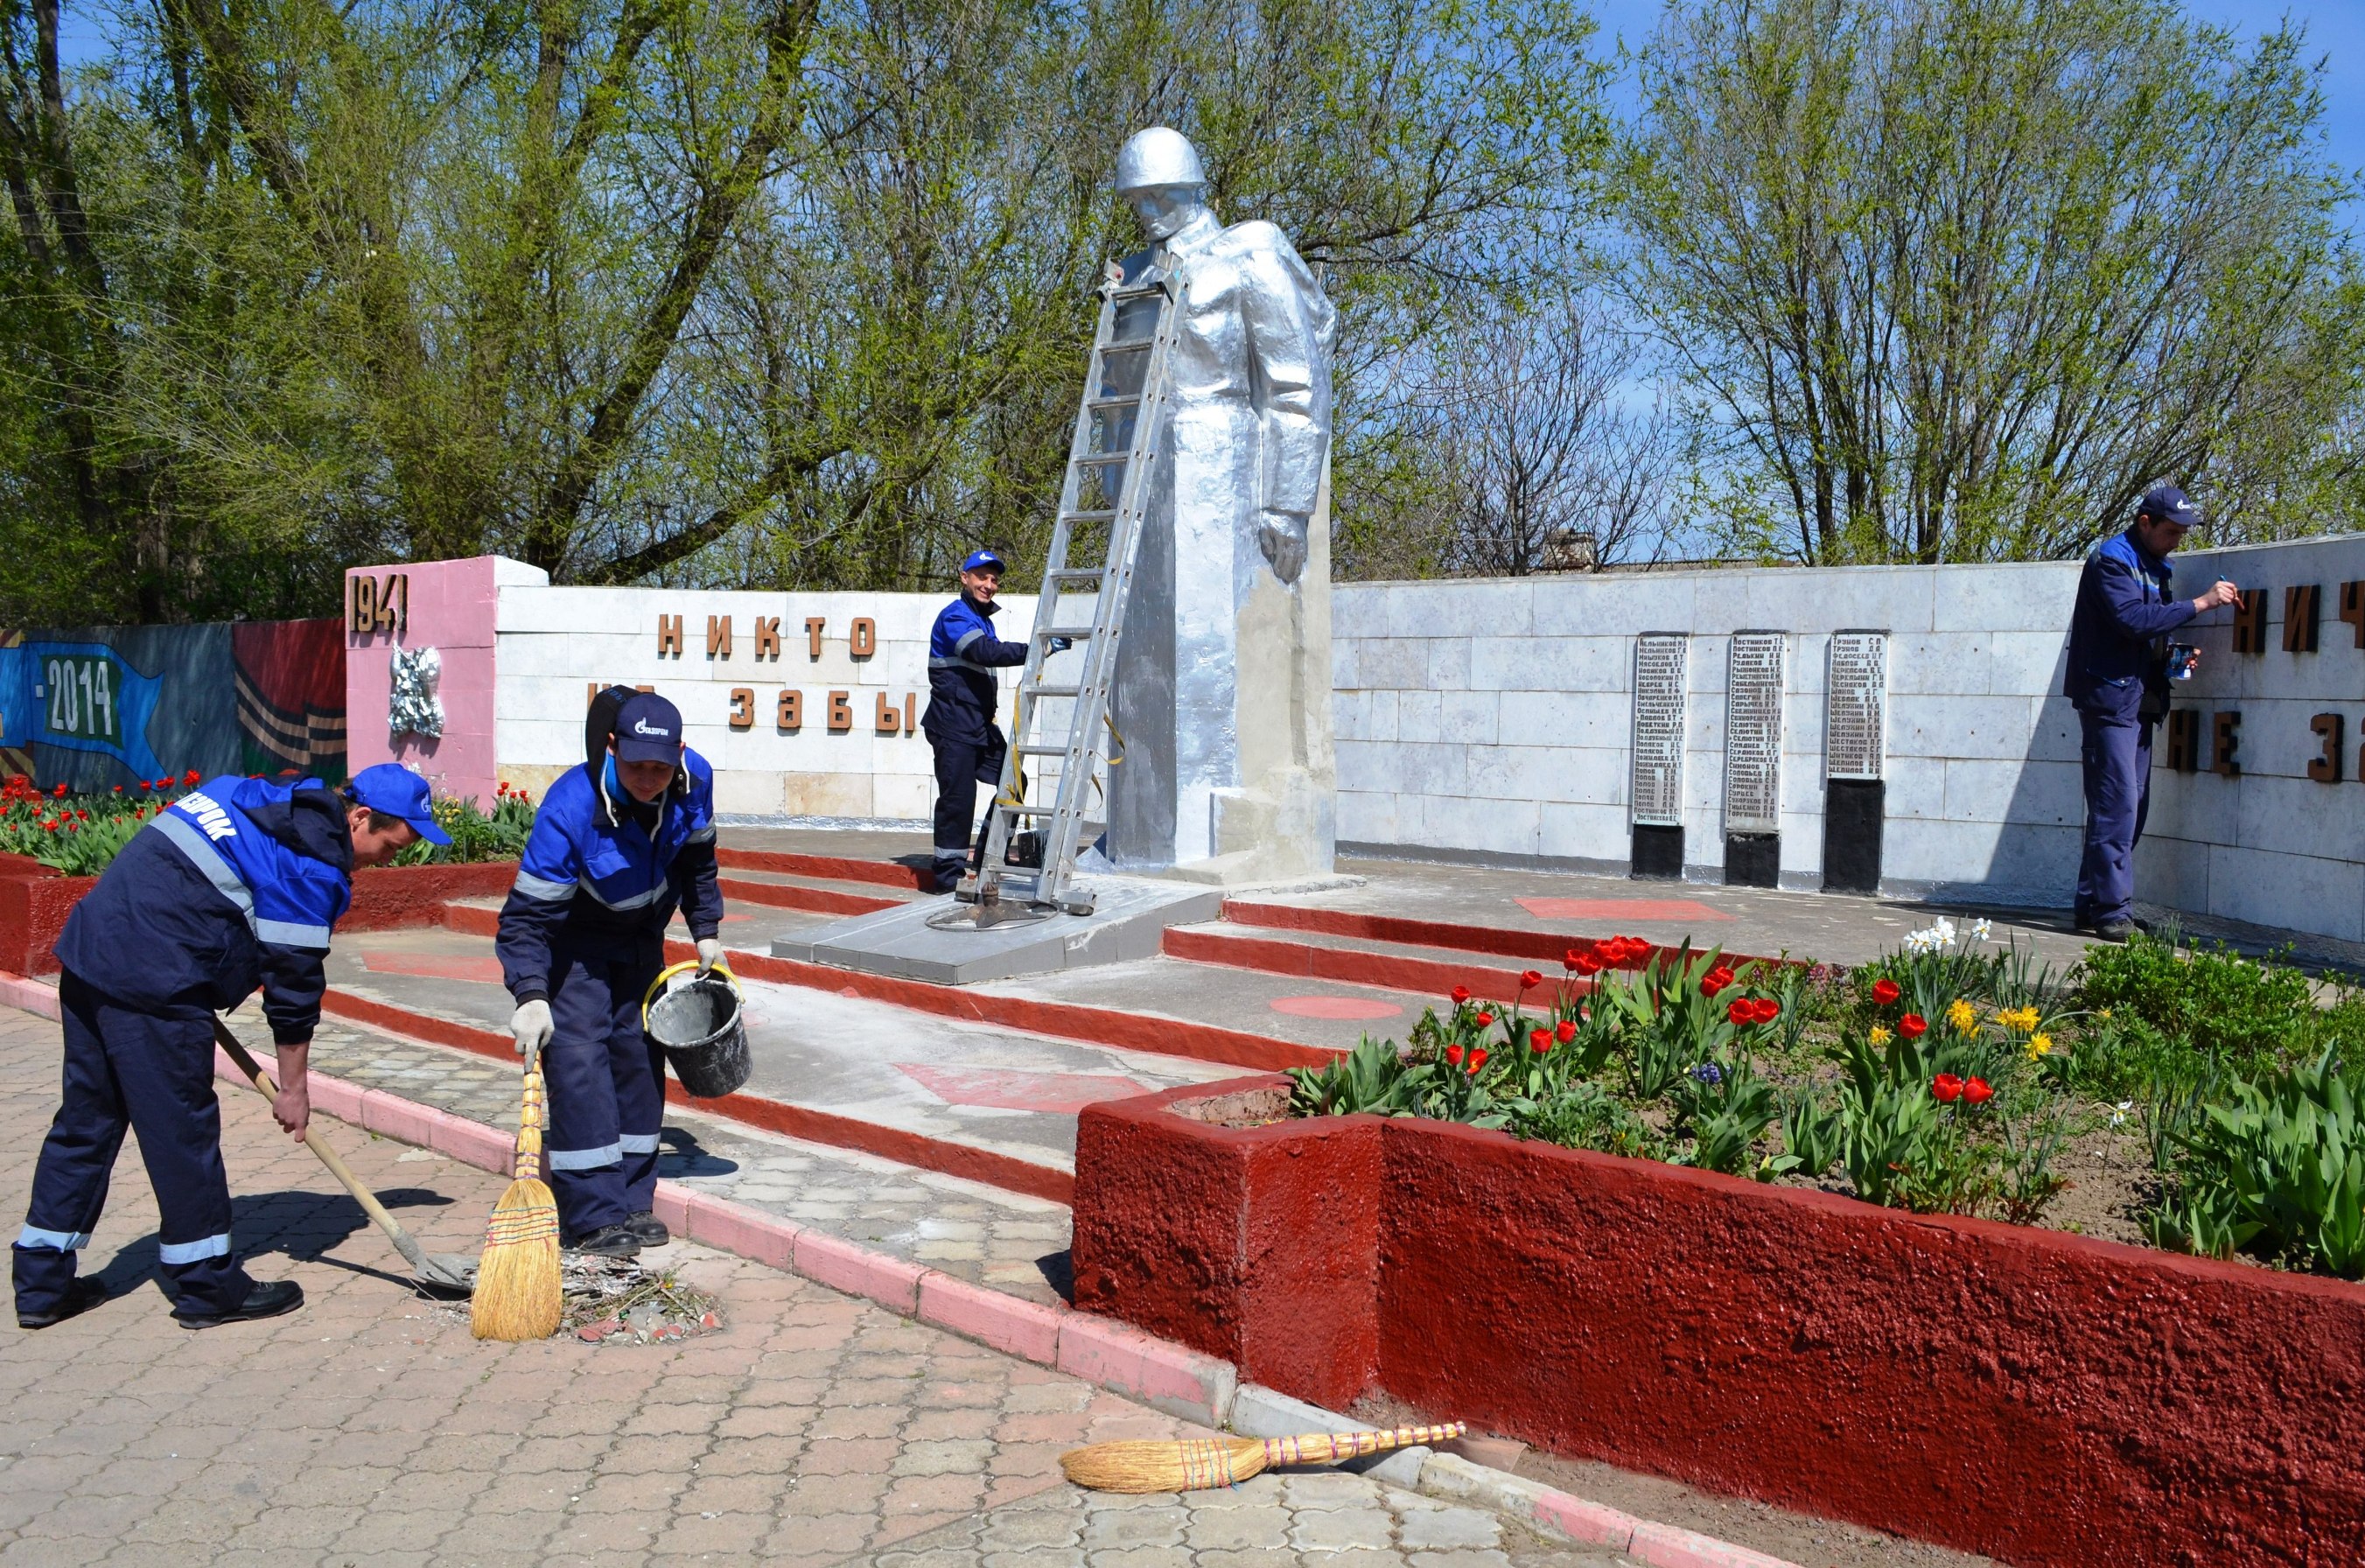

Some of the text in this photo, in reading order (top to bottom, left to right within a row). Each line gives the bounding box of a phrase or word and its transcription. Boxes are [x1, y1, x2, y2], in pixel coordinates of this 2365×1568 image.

[349, 574, 408, 632] 1941
[658, 613, 875, 656] НИКТО
[729, 688, 915, 732] ЗАБЫ
[2166, 710, 2365, 783] НЕ З
